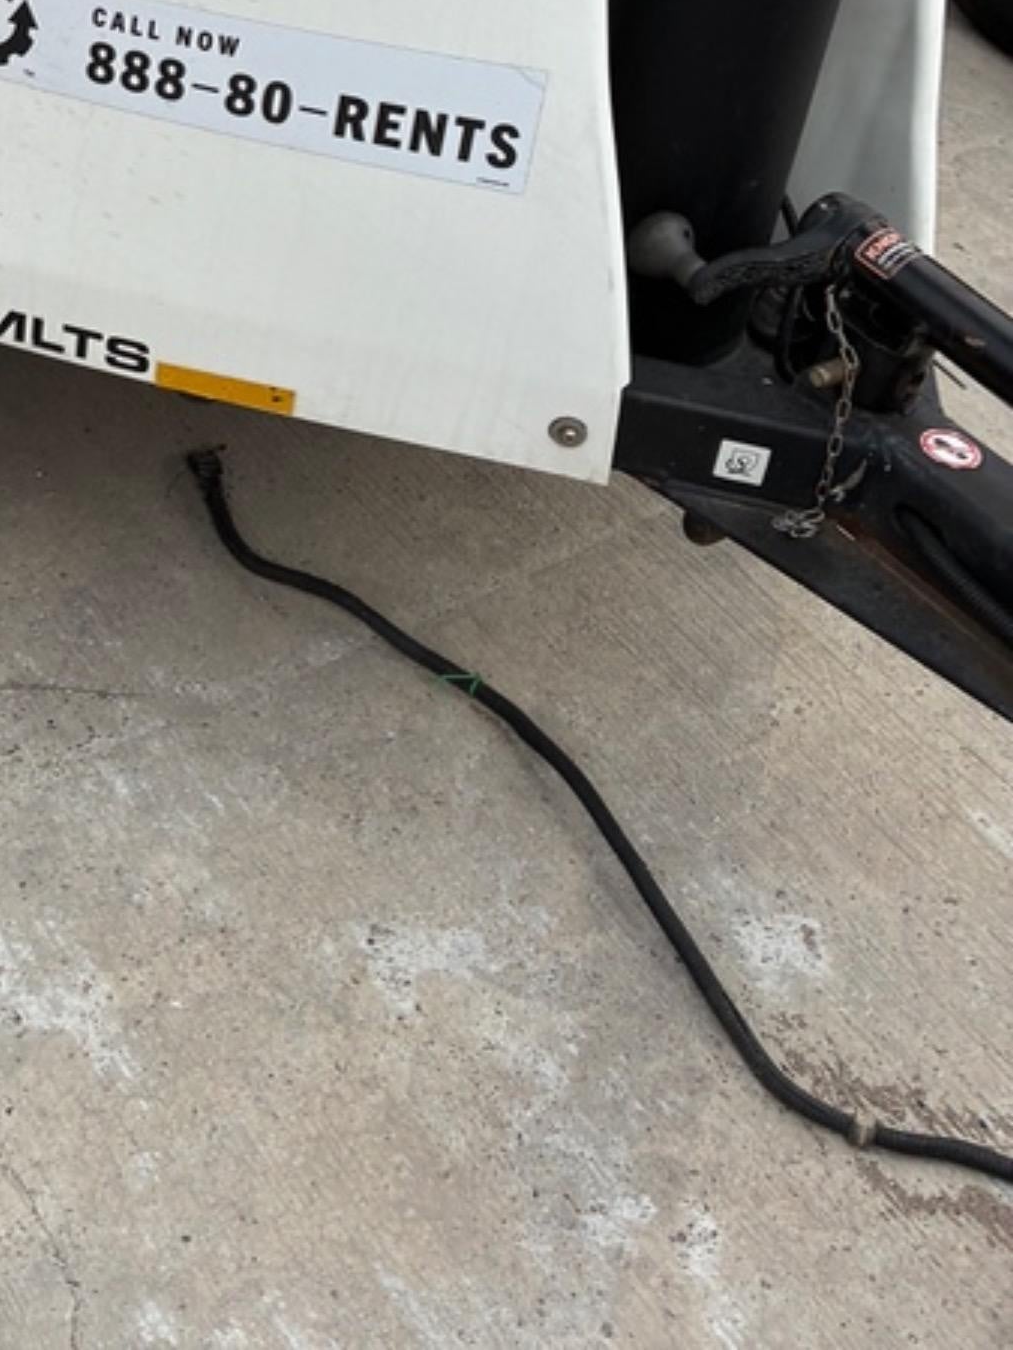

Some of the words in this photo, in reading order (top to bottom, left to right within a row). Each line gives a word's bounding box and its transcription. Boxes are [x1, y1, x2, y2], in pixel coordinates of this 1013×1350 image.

[91, 6, 161, 41] CALL
[175, 26, 241, 58] NOW
[86, 41, 521, 170] 888-80-RENTS
